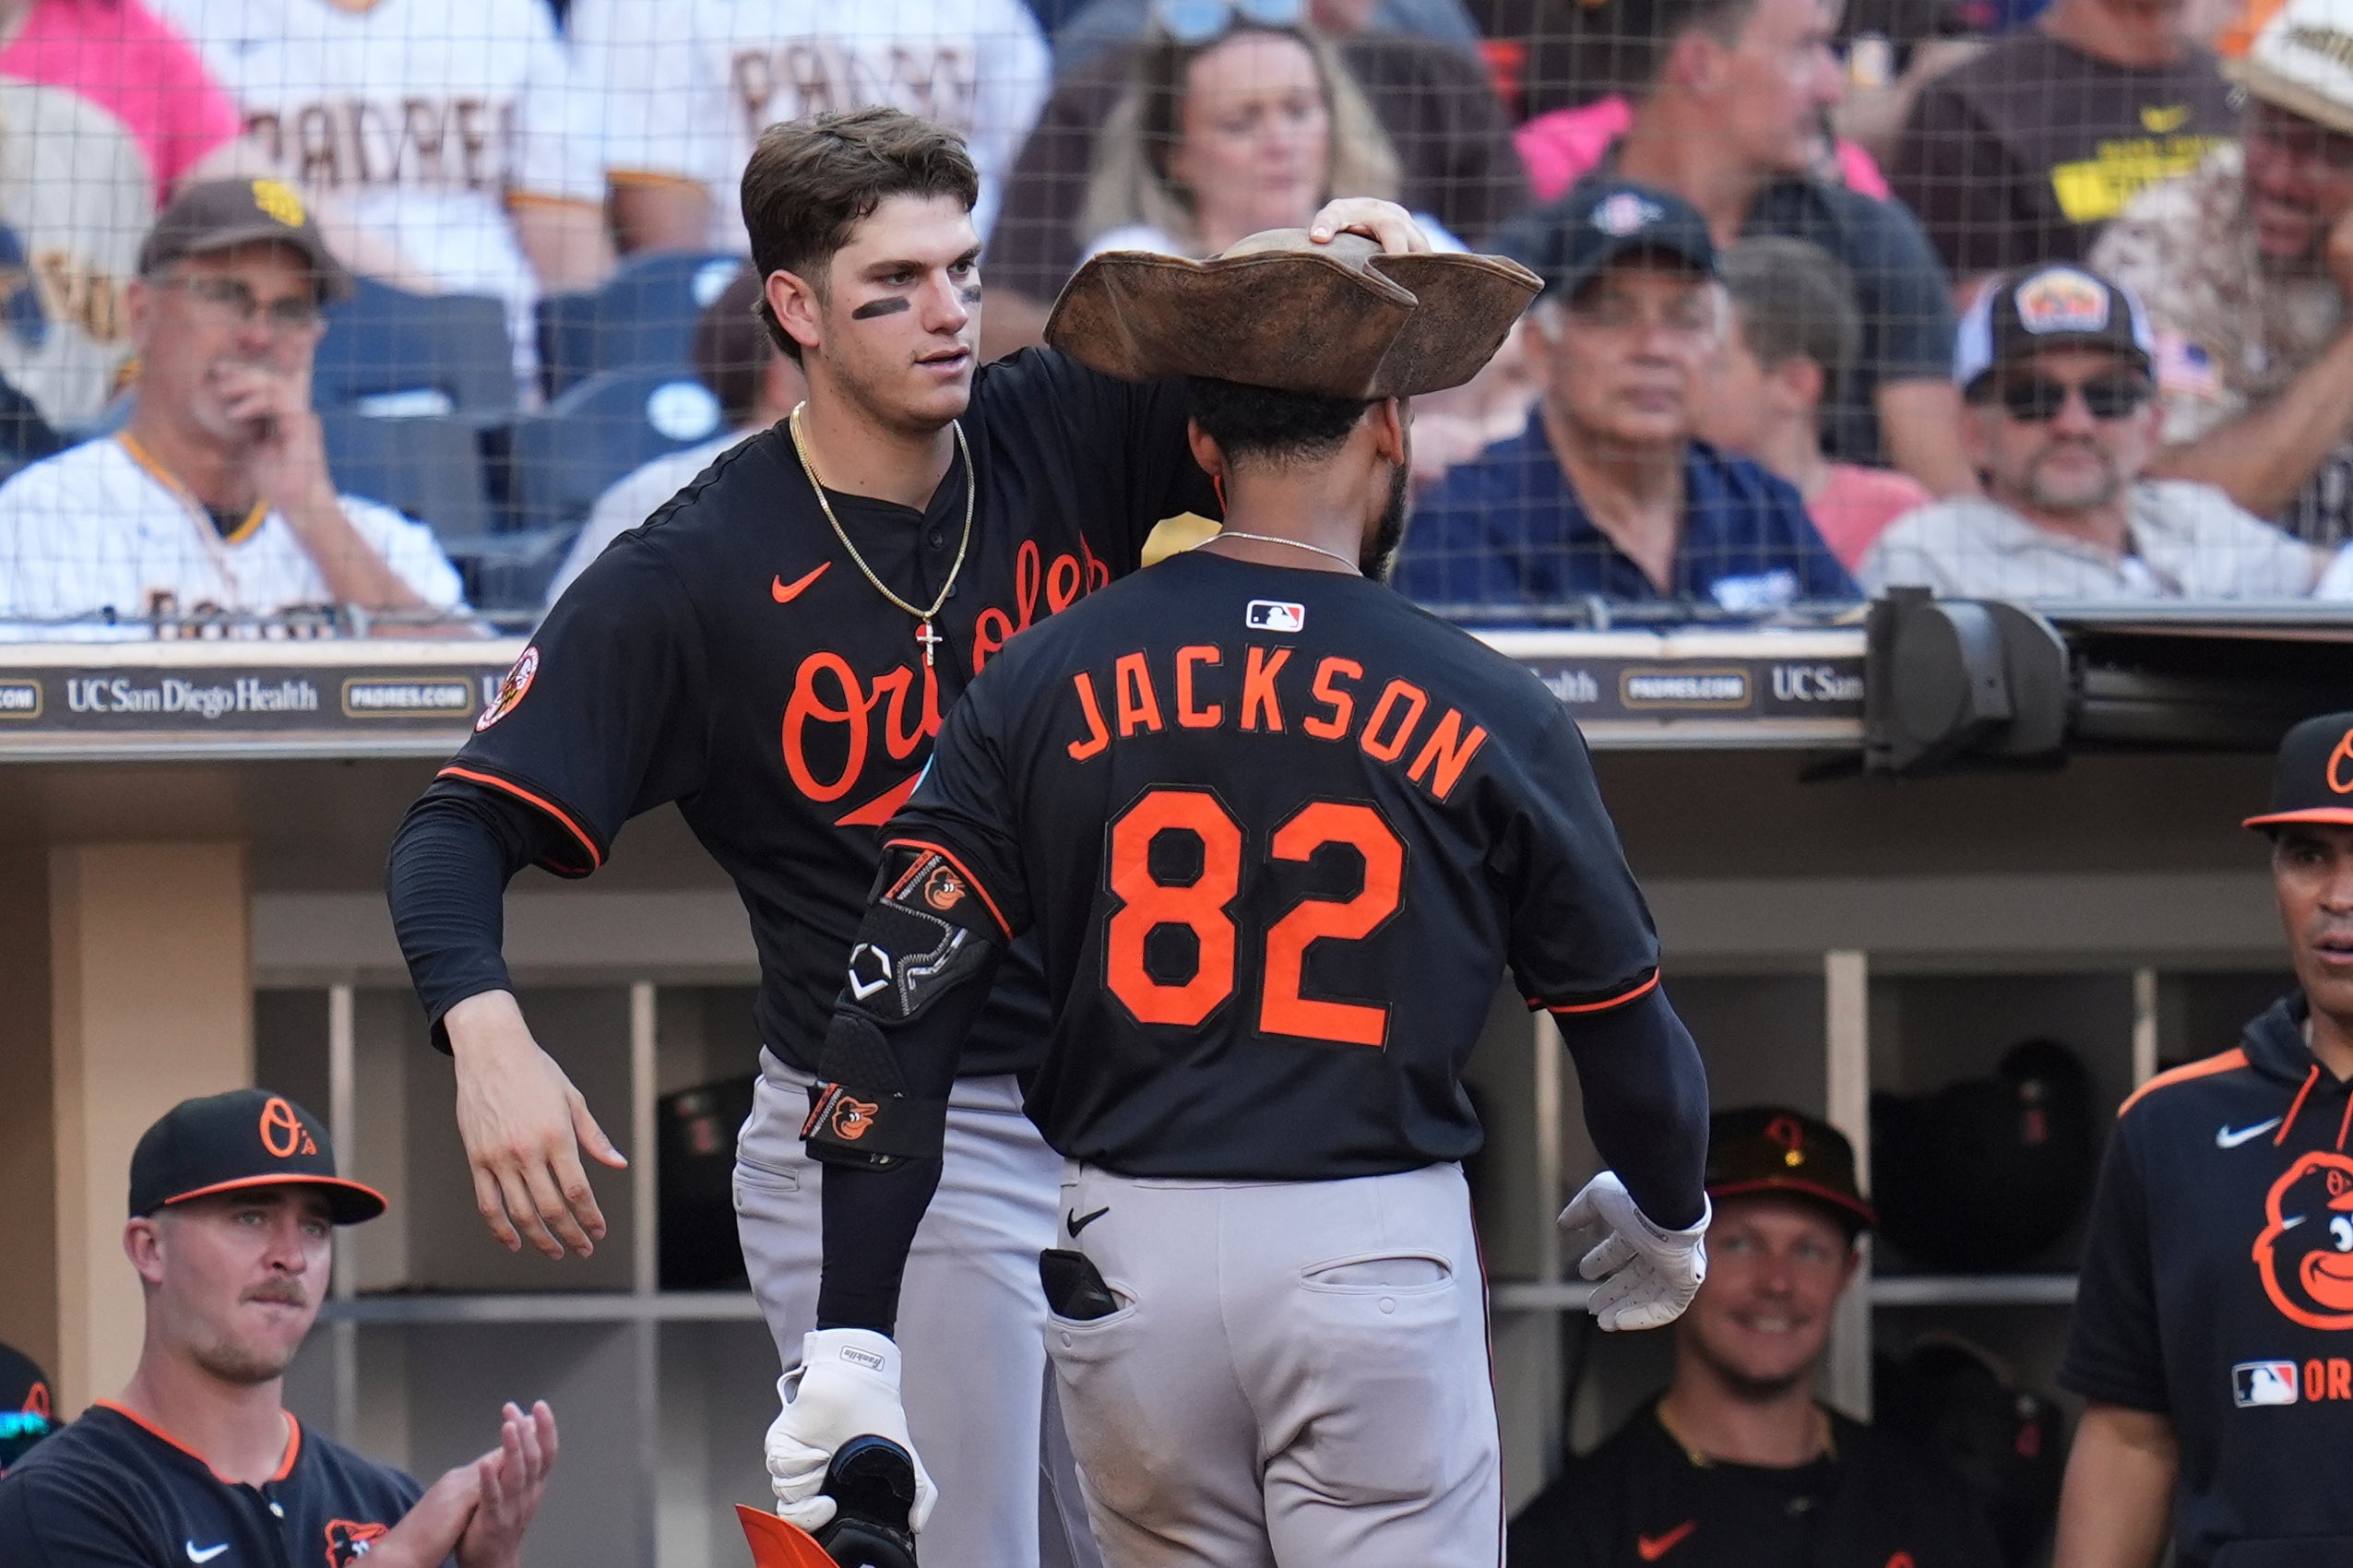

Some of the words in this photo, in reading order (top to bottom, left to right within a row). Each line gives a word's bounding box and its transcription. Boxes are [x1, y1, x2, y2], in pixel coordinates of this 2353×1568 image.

[67, 678, 109, 712] UC
[111, 678, 160, 712] San
[161, 678, 235, 719] Diego
[236, 677, 318, 711] Health
[1066, 644, 1488, 801] JACKSON
[1772, 664, 1814, 701] UC
[1106, 787, 1408, 1049] 82
